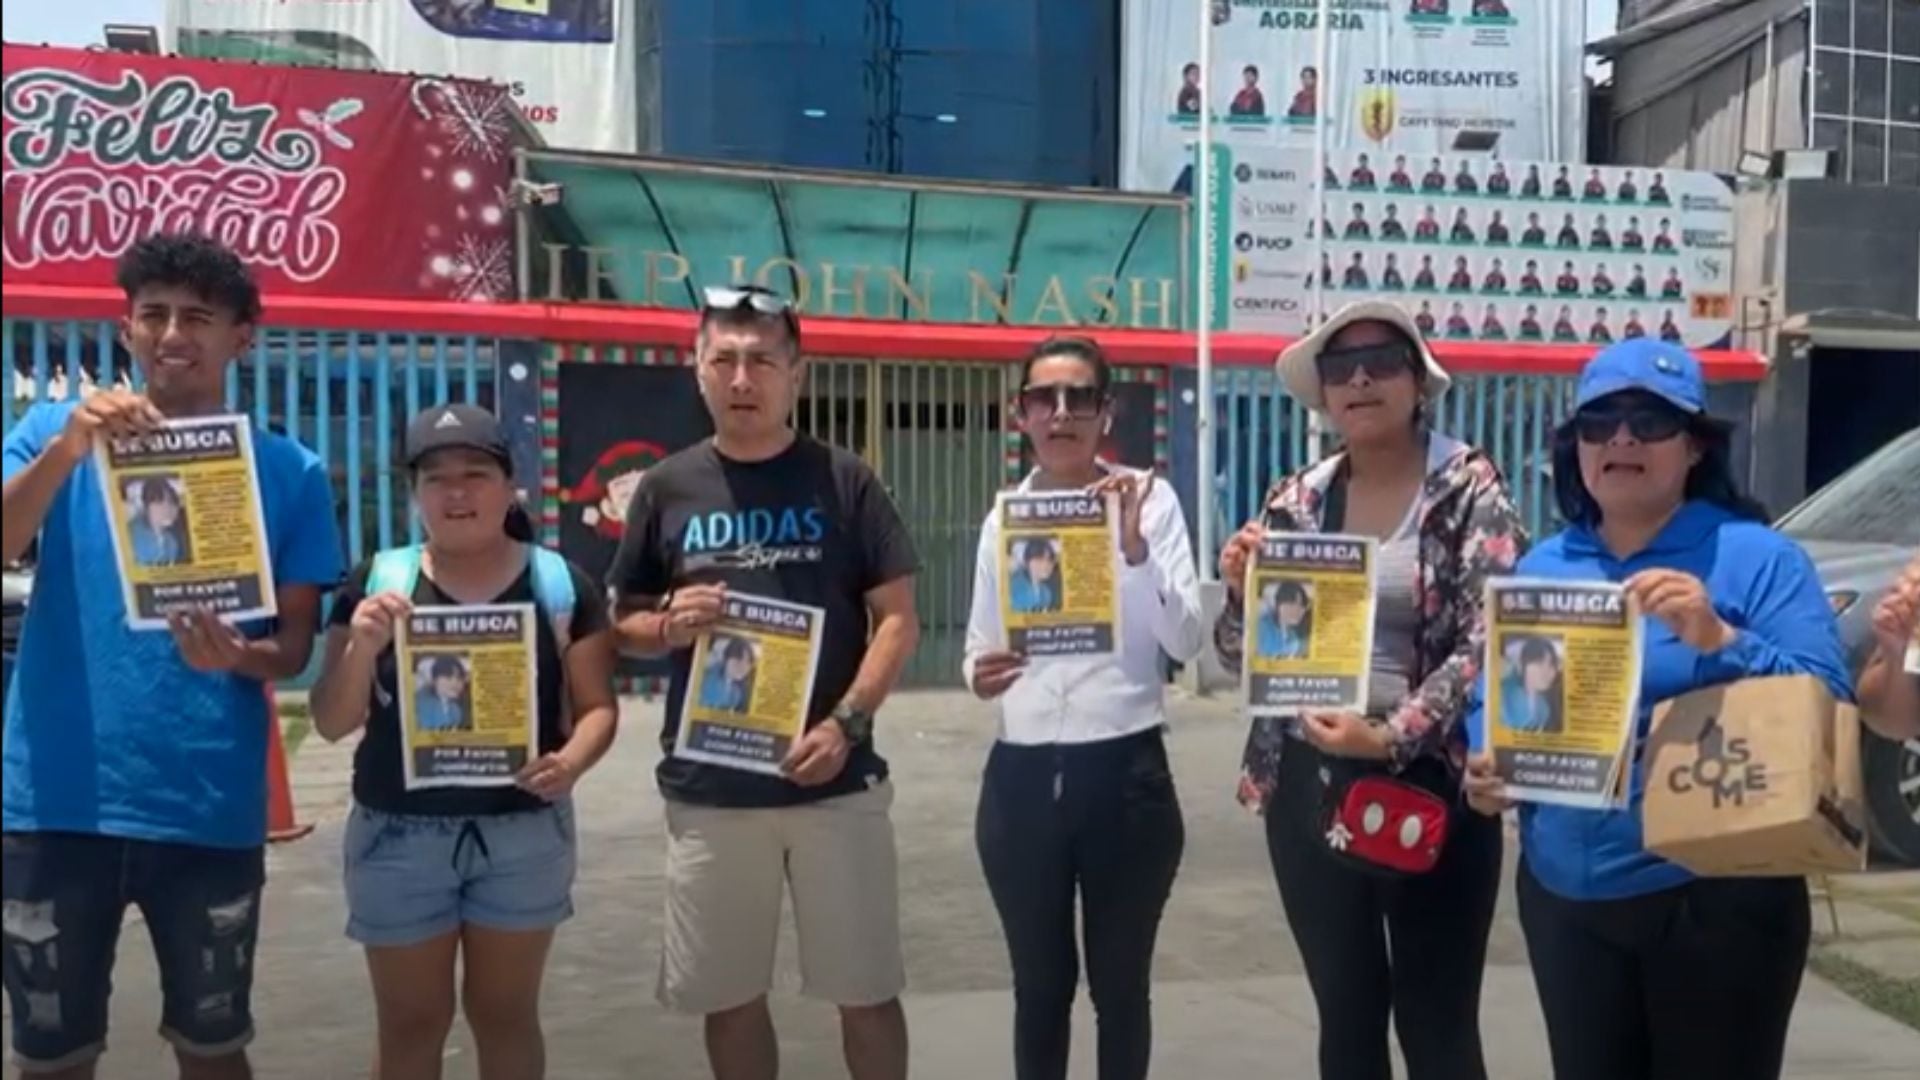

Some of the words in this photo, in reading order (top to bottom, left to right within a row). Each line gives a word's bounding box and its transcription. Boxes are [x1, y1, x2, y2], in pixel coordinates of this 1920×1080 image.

[1363, 69, 1375, 84] 3
[1380, 69, 1519, 87] INGRESANTES
[3, 68, 320, 175] Feliz
[1257, 237, 1293, 249] PUCP
[967, 269, 1174, 329] NASH
[1036, 501, 1102, 518] BUSCA
[683, 507, 824, 552] ADIDAS
[1293, 544, 1361, 560] BUSCA
[1502, 592, 1531, 610] SE
[1540, 593, 1622, 613] BUSCA
[412, 617, 439, 633] SE
[445, 615, 518, 632] BUSCA
[745, 604, 807, 629] BUSCA
[1513, 752, 1546, 766] POR
[1550, 753, 1599, 770] FAVOR
